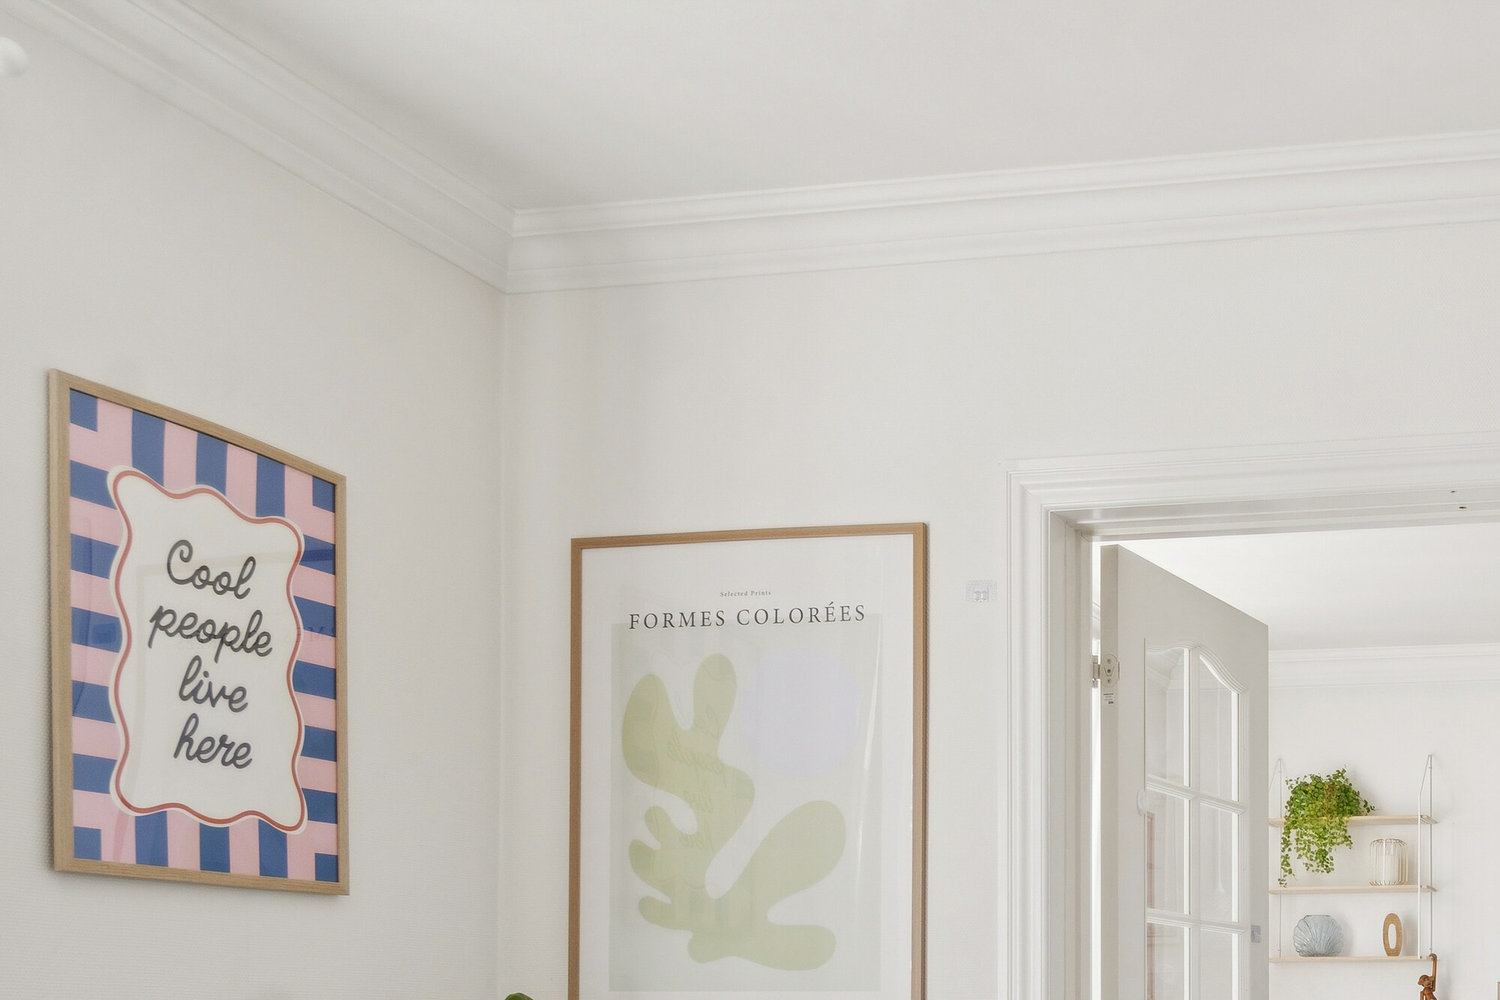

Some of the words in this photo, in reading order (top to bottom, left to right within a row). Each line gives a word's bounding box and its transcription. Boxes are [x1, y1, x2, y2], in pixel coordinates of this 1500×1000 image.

[167, 539, 256, 600] Cool
[148, 605, 273, 663] people
[629, 609, 725, 630] FORMES
[736, 600, 865, 626] COLORÉES
[178, 655, 248, 713] live
[173, 713, 252, 769] here
